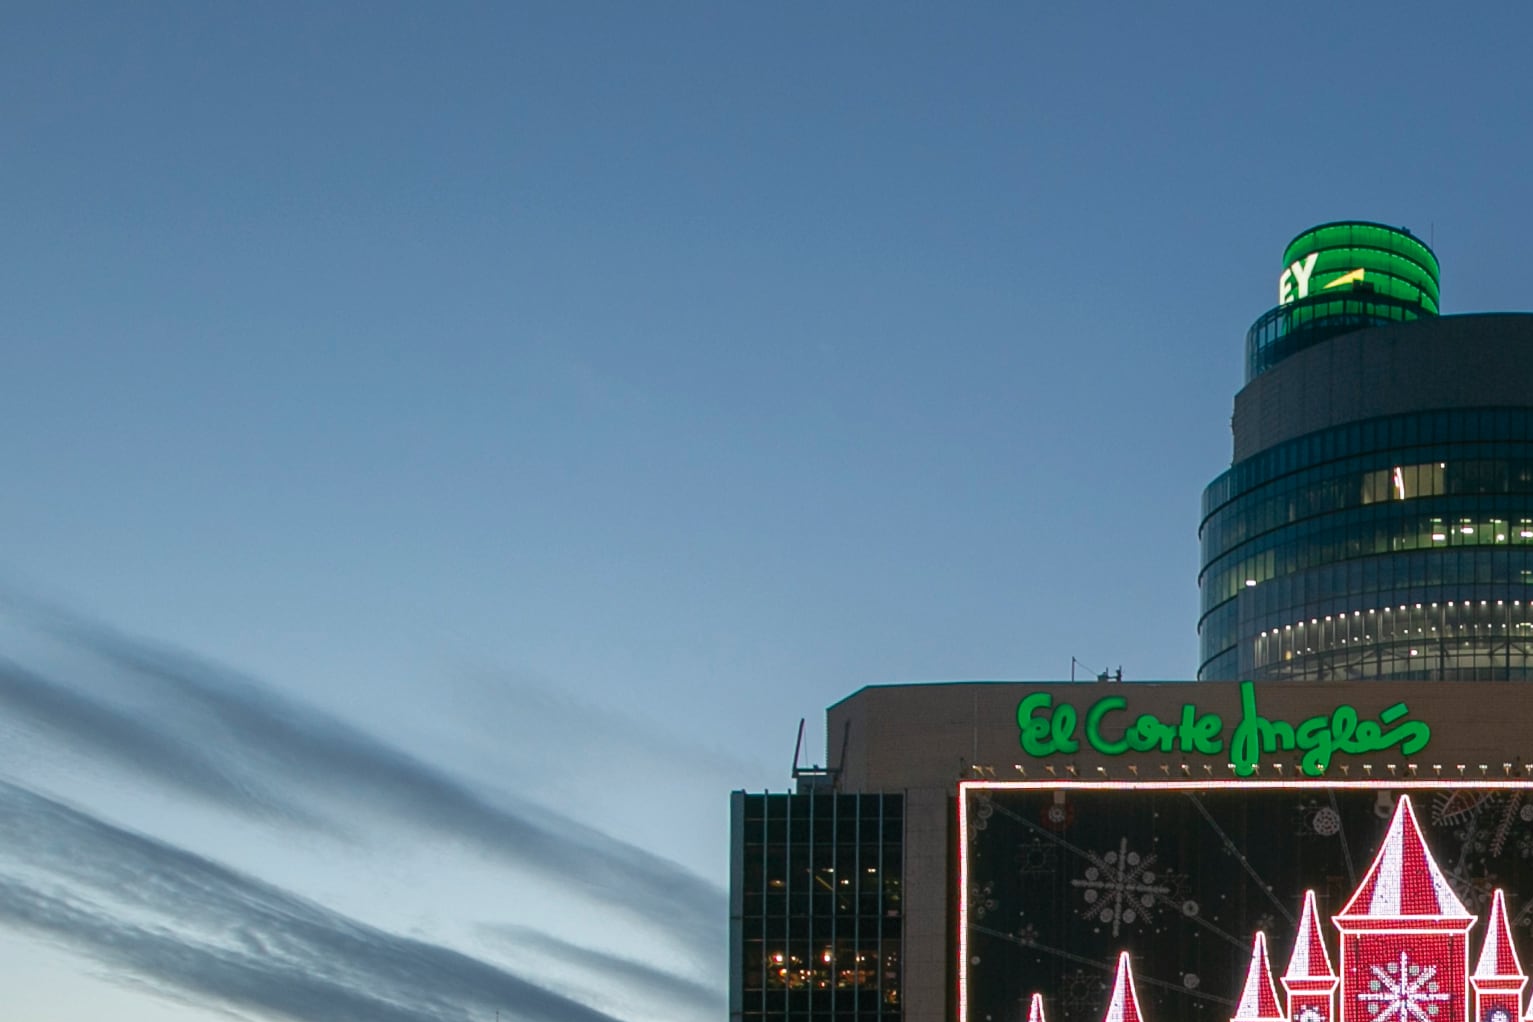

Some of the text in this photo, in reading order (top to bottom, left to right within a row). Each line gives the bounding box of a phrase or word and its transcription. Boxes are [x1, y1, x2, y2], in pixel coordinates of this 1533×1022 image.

[1279, 252, 1319, 305] EY
[1015, 680, 1432, 778] El Corte Inglés
